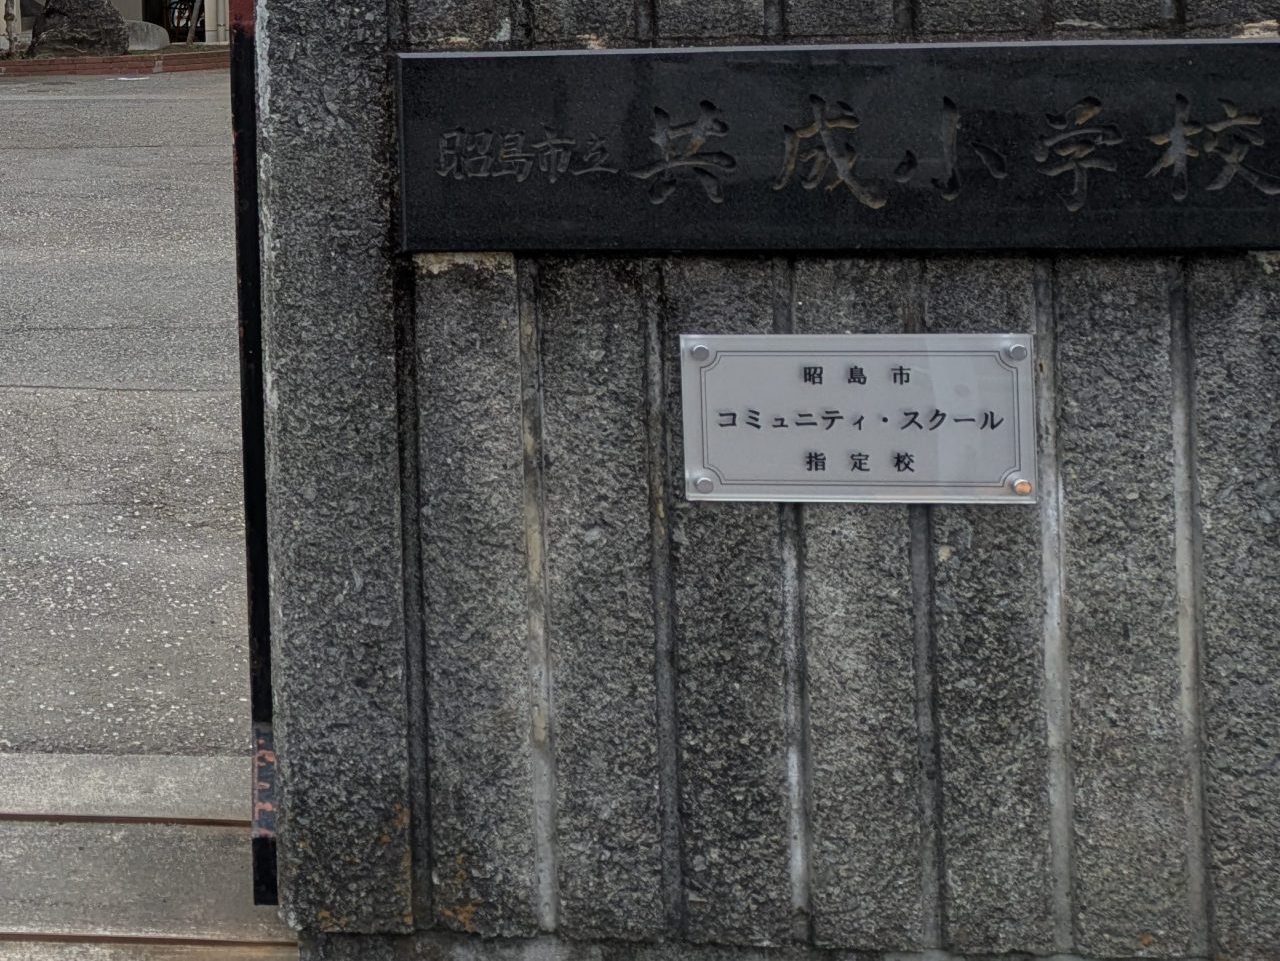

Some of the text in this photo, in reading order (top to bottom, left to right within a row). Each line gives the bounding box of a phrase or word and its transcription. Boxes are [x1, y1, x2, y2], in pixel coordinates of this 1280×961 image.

[718, 408, 1004, 431] コミュニティ・スクール
